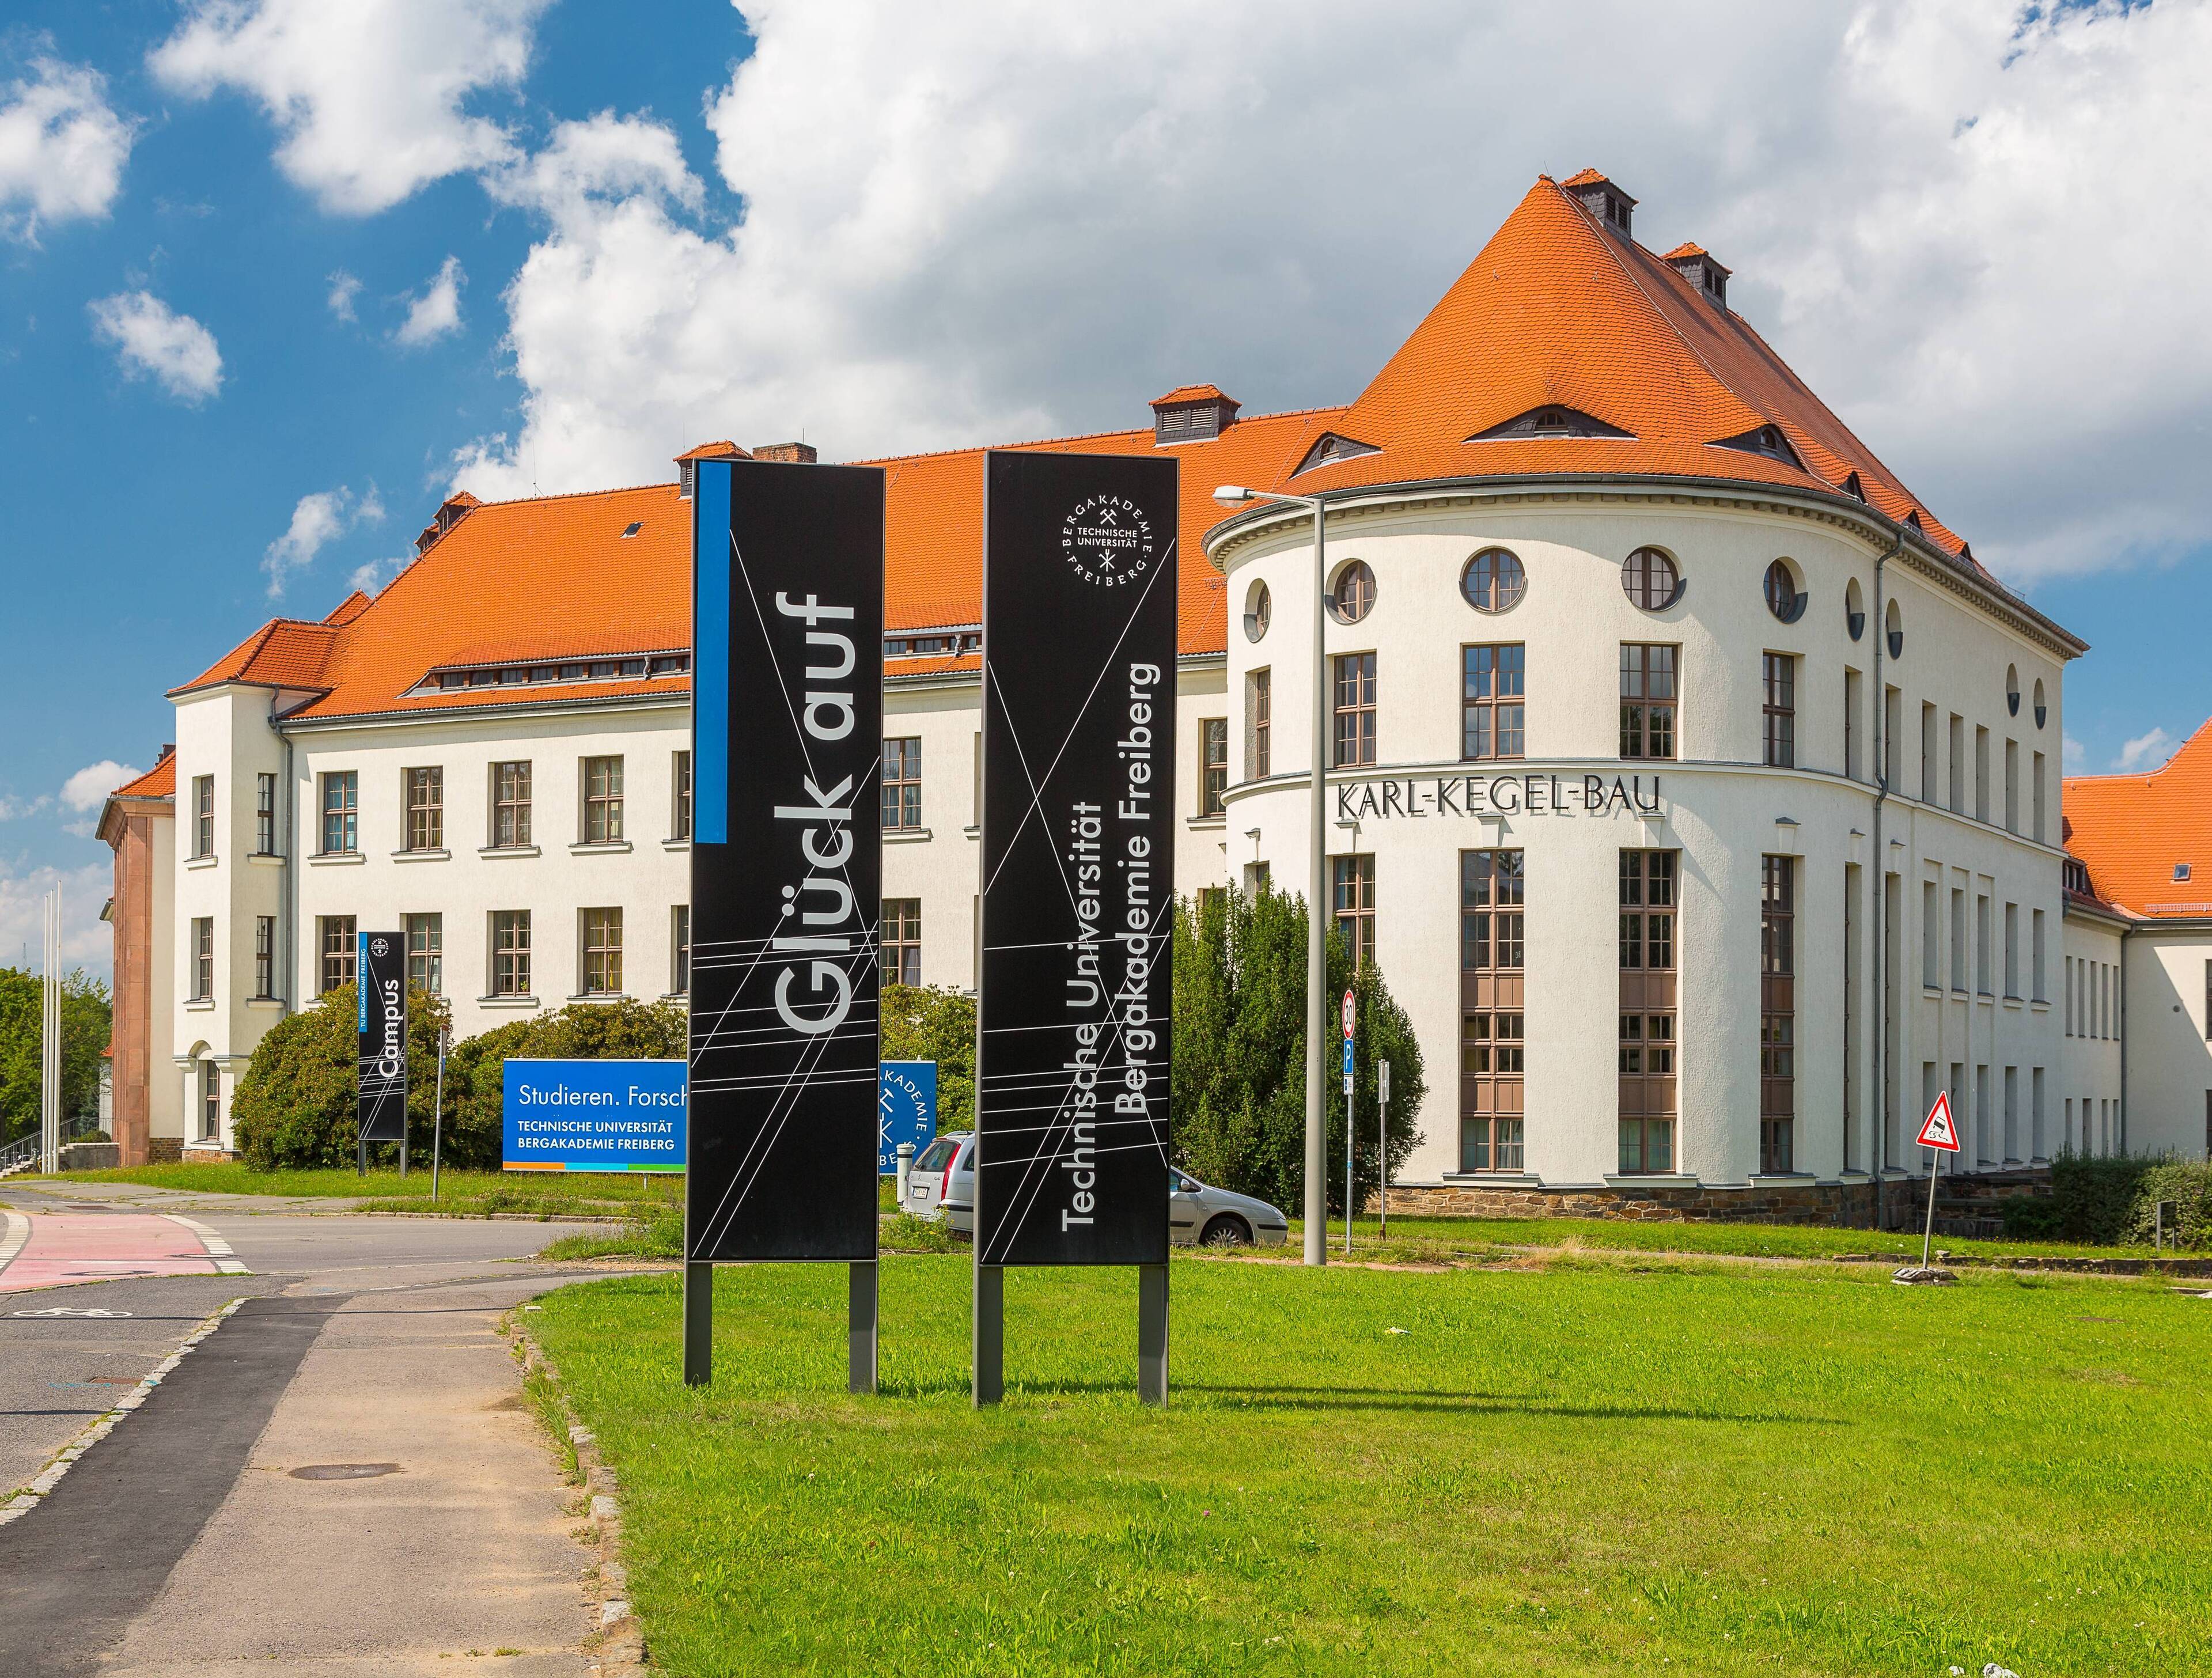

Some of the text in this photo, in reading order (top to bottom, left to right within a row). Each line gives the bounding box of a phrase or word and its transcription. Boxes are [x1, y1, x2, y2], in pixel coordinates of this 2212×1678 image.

[1063, 495, 1152, 552] BERGAKADEMIE
[1077, 527, 1137, 538] TECHNISCHE
[1077, 537, 1138, 548] UNIVERSITÄT
[1067, 555, 1147, 586] FREIBERG
[1337, 775, 1660, 818] KARL-KEGEL-BAU
[772, 592, 855, 1034] Glück auf
[1115, 663, 1161, 1114] Bergakademie Freiberg
[361, 1019, 366, 1027] TU
[1062, 801, 1101, 1232] Technische Universität
[1345, 1004, 1352, 1025] 30
[378, 979, 403, 1078] Campus
[1346, 1044, 1351, 1070] P
[518, 1084, 620, 1106] Studieren.
[518, 1119, 673, 1133] TECHNISCHE UNIVERSITÄT
[518, 1138, 675, 1150] BERGAKADEMIE FREIBERG
